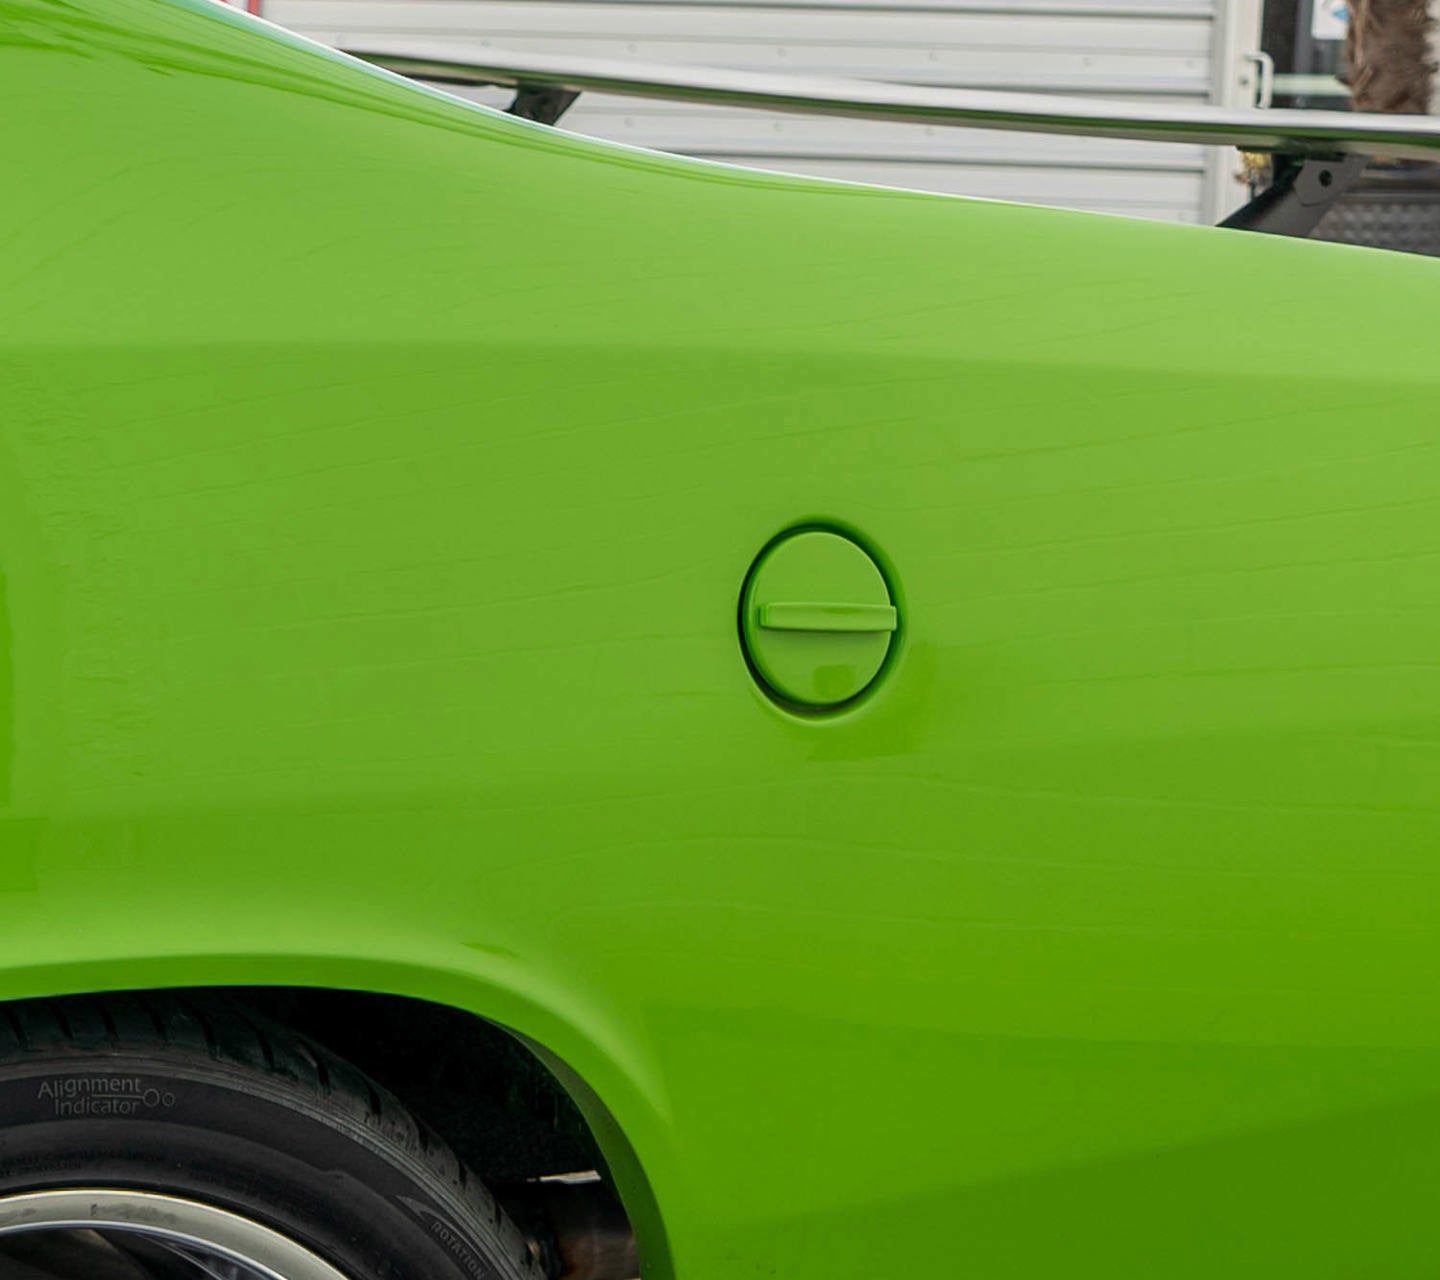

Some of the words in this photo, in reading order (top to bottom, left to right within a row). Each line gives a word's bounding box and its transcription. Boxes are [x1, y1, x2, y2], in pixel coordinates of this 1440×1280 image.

[37, 1077, 142, 1099] Alignment
[55, 1096, 140, 1115] Indicator
[431, 1221, 485, 1280] ROTATION
